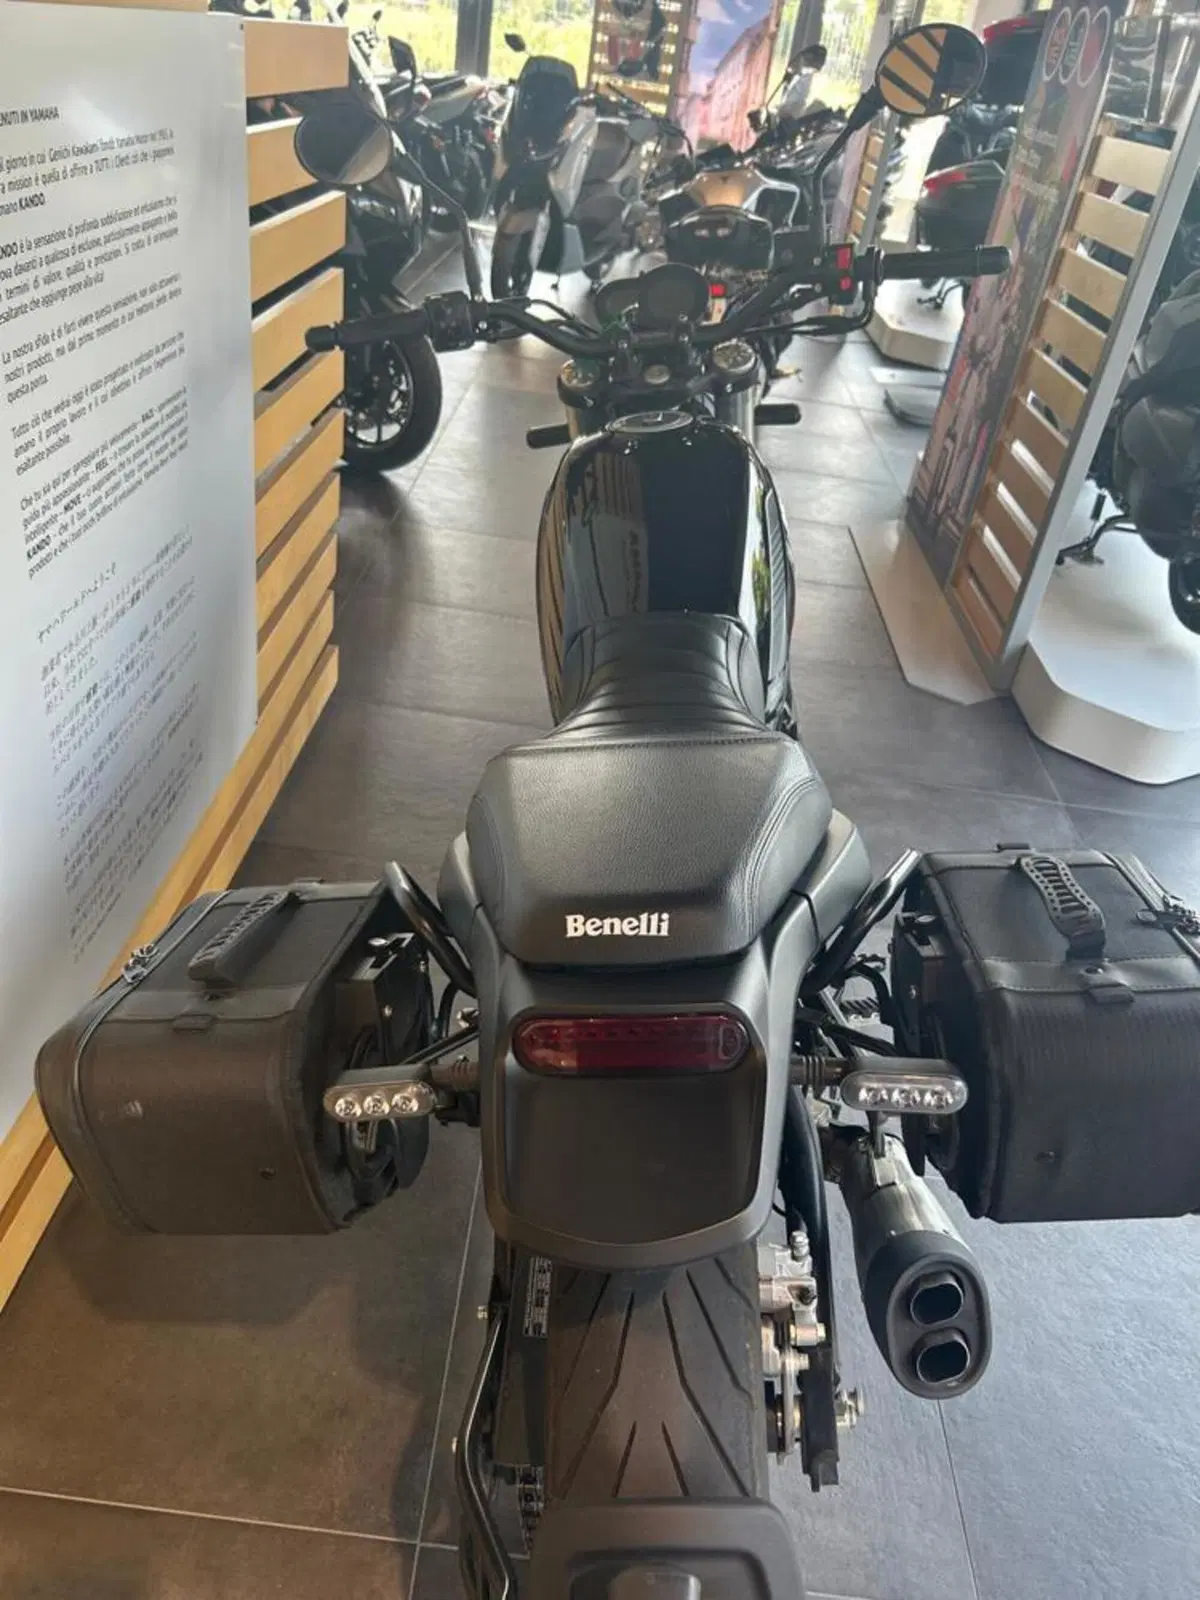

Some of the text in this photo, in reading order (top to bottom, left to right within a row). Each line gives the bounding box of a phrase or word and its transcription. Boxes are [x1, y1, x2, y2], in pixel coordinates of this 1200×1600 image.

[20, 109, 29, 123] IN
[29, 107, 59, 122] YAMAHA
[8, 176, 33, 192] mission
[42, 167, 60, 186] quella
[18, 192, 46, 211] KANDO
[33, 229, 66, 249] sensazione
[1, 350, 11, 366] La
[12, 340, 34, 360] nostra
[565, 912, 670, 938] Benelli
